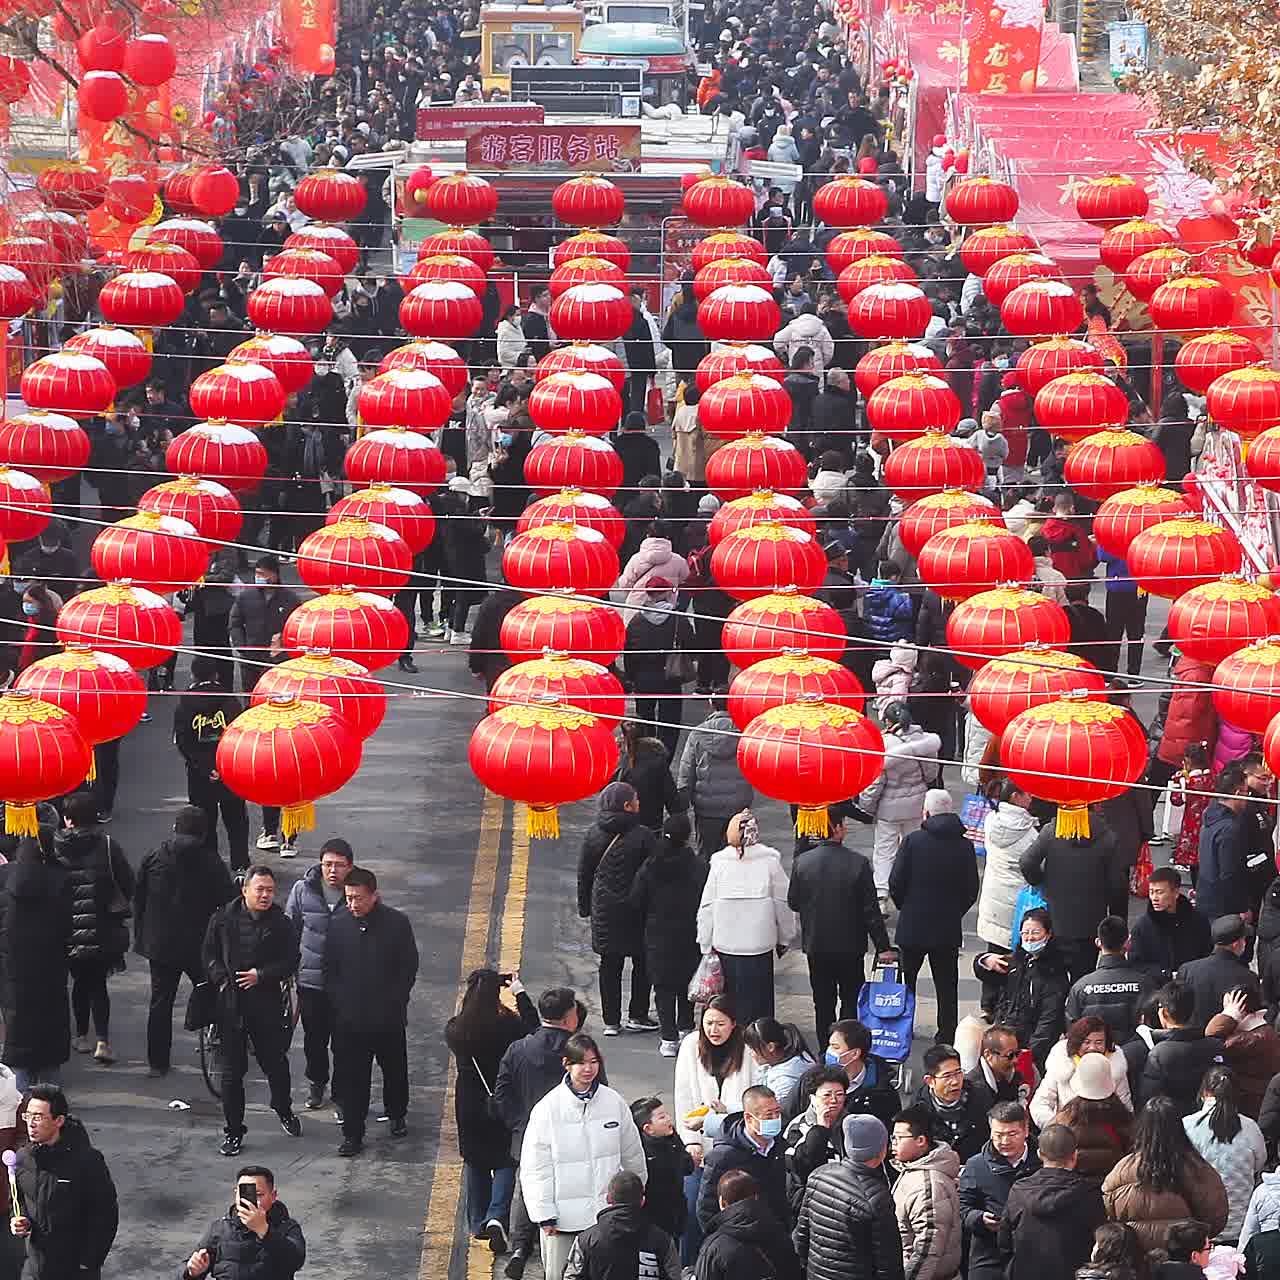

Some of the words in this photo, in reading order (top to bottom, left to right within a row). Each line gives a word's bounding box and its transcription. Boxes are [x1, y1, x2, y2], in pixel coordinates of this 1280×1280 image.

[481, 133, 622, 163] 游客服务站
[1093, 983, 1140, 994] DESCENTE
